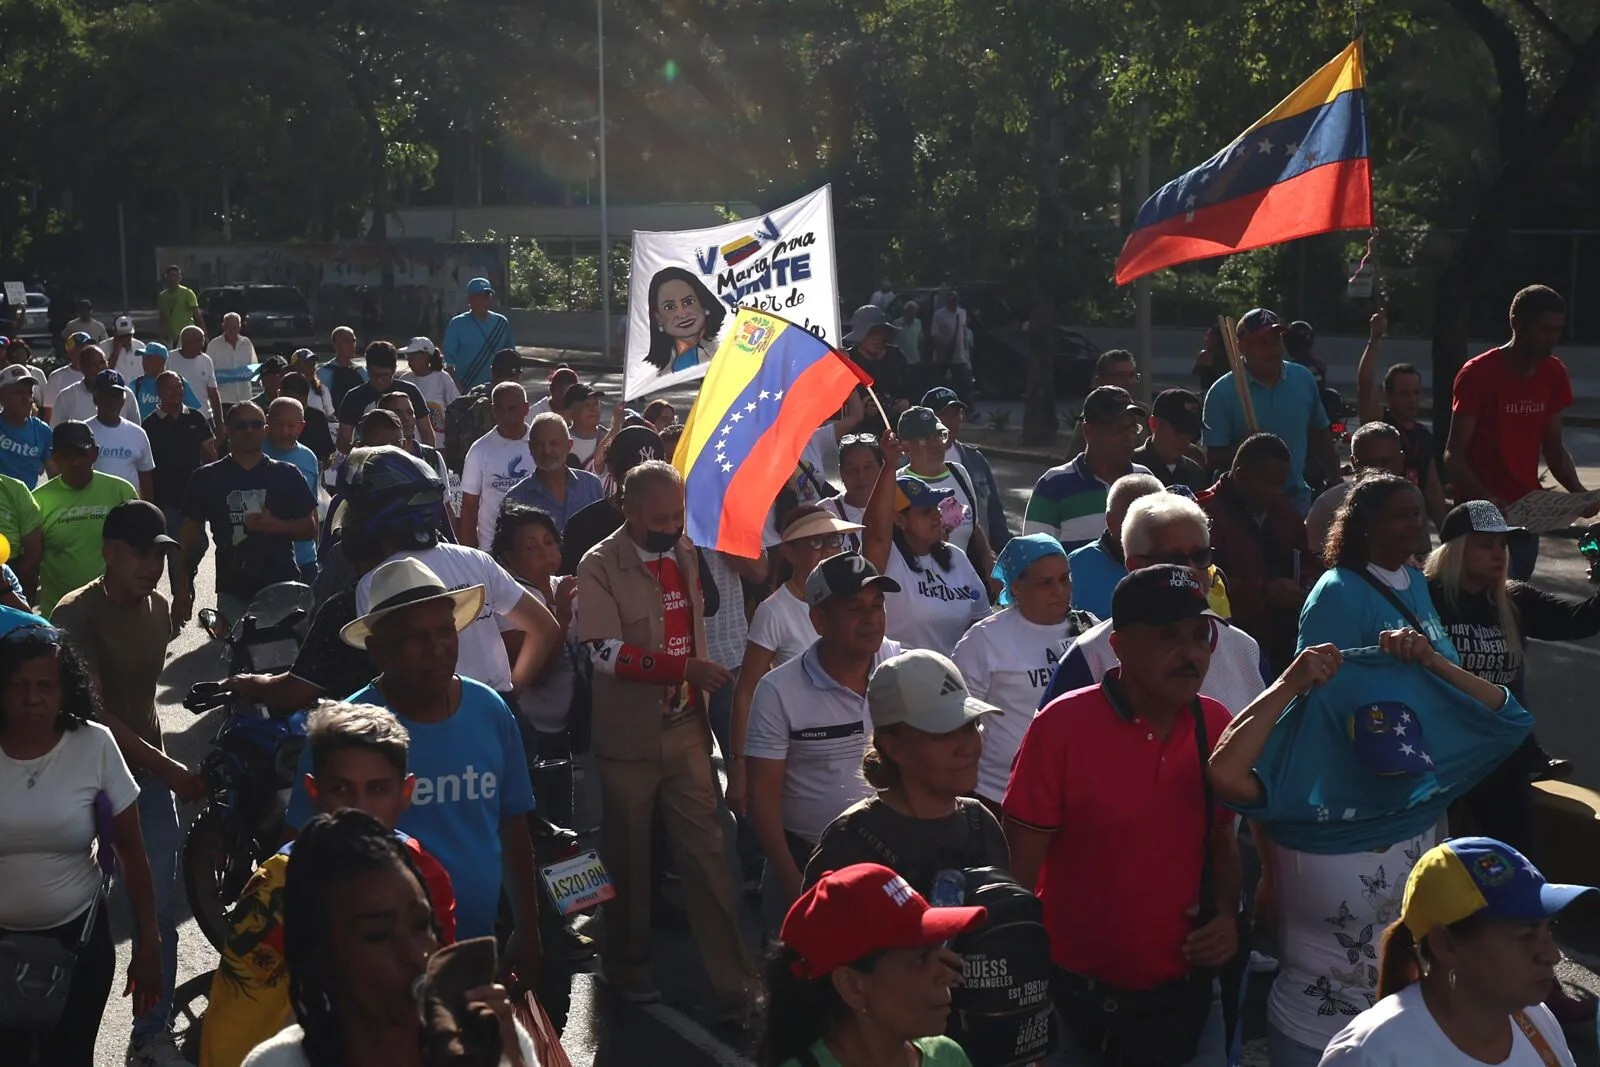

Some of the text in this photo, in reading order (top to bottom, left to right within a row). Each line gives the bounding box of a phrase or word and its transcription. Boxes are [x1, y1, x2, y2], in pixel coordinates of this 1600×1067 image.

[785, 287, 806, 308] de
[1456, 636, 1471, 652] LA
[1473, 638, 1511, 655] LIBERA
[411, 764, 497, 806] ente
[961, 957, 1009, 979] GUESS
[963, 974, 1014, 990] LOS ANGELES
